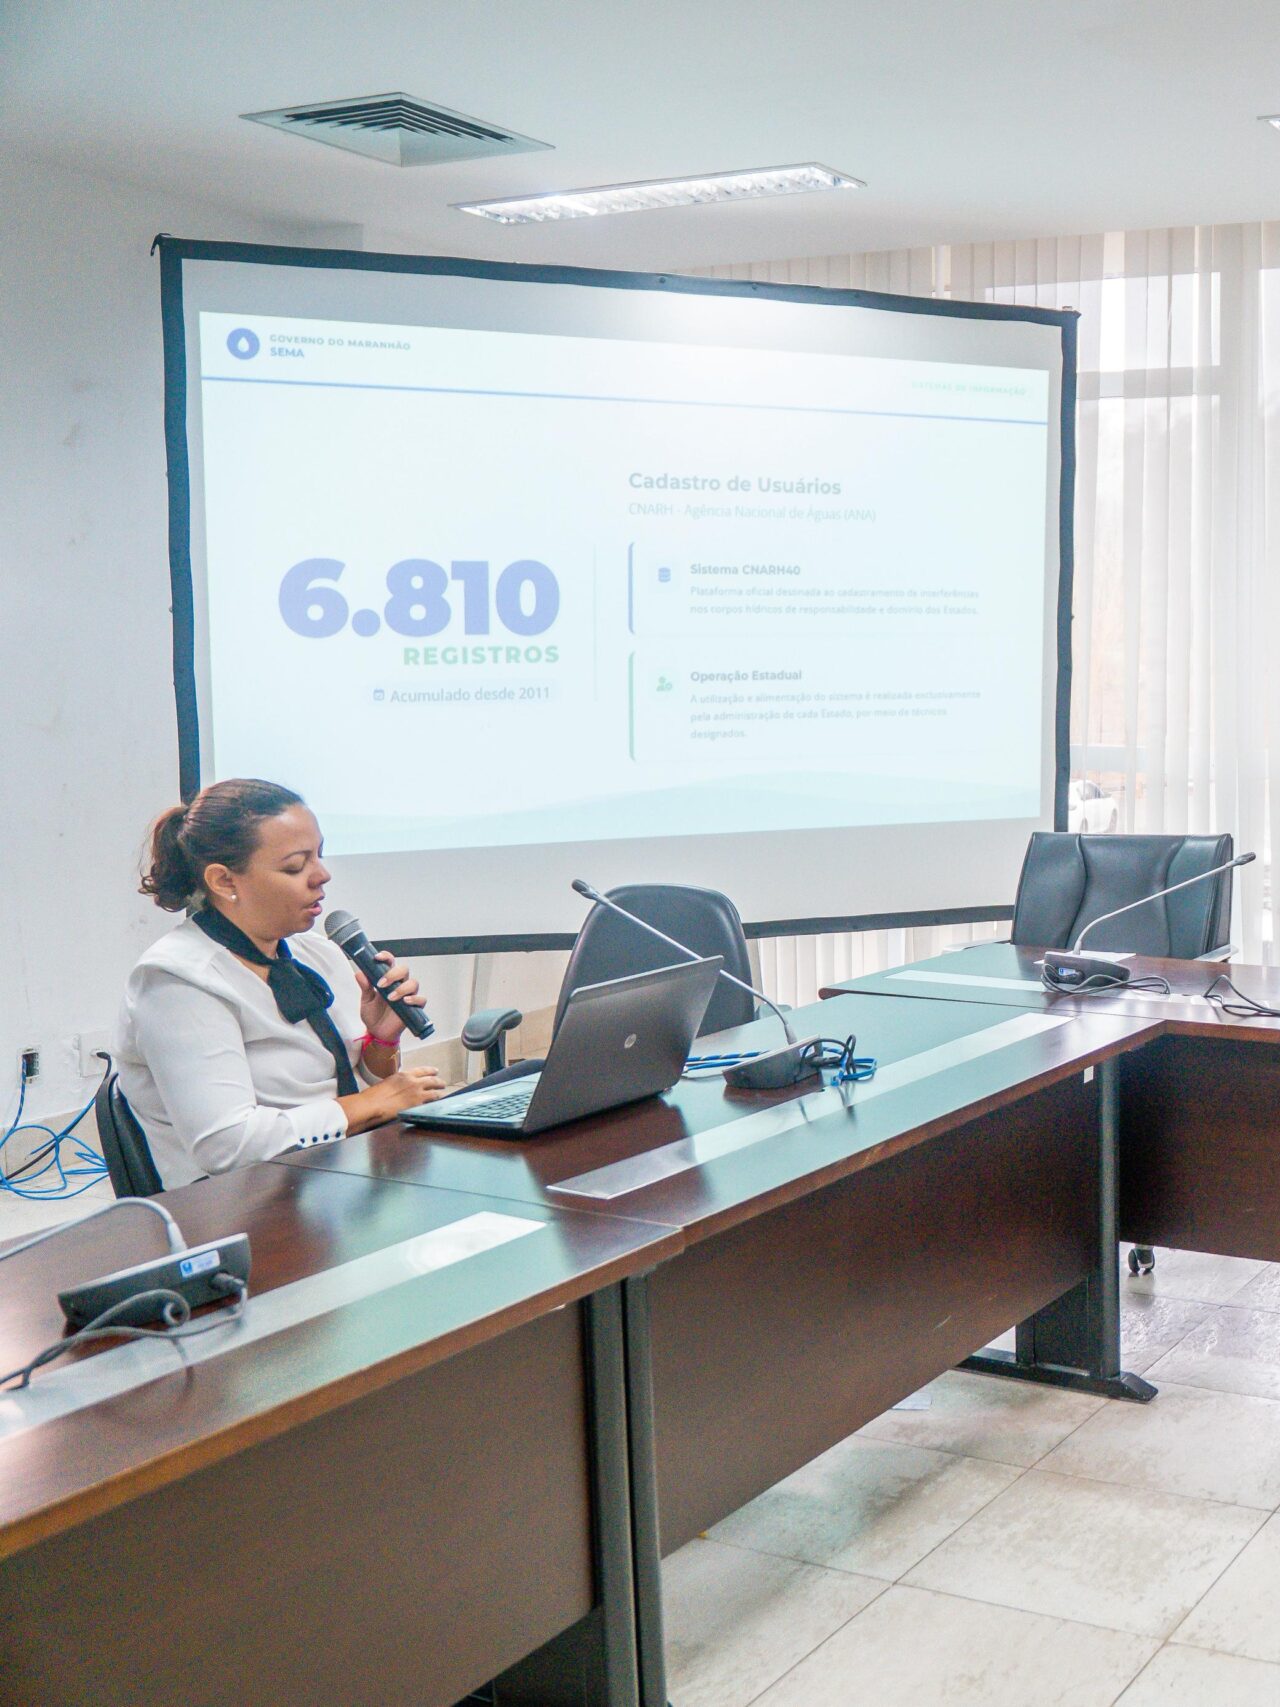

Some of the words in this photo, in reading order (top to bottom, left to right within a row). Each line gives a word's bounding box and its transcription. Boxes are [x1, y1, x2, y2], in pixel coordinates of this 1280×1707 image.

[270, 335, 325, 346] GOVERNO
[328, 338, 344, 347] DO
[347, 339, 411, 351] MARANHÃO
[270, 347, 305, 358] SEMA
[628, 472, 721, 491] Cadastro
[727, 475, 751, 492] de
[758, 476, 842, 495] Usuários
[628, 503, 674, 516] CNARH
[684, 503, 732, 520] Agência
[735, 504, 786, 519] Nacional
[789, 505, 804, 520] de
[806, 504, 842, 523] Águas
[843, 508, 877, 523] (ANA)
[690, 563, 739, 575] Sistema
[742, 564, 801, 576] CNARH40
[278, 557, 561, 639] 6.810
[690, 586, 743, 597] Plataforma
[746, 586, 774, 597] oficial
[824, 589, 835, 597] ao
[907, 587, 918, 598] de
[690, 605, 709, 614] nos
[710, 605, 743, 616] corpos
[785, 603, 797, 614] de
[925, 604, 941, 615] dos
[403, 645, 560, 666] REGISTROS
[690, 670, 749, 683] Operação
[752, 670, 803, 681] Estadual
[390, 688, 471, 703] Acumulado
[474, 686, 515, 701] desde
[519, 686, 550, 700] 2011
[690, 694, 698, 704] A
[700, 693, 745, 705] utilização
[755, 692, 811, 704] alimentação
[814, 691, 826, 701] do
[690, 711, 711, 723] pela
[713, 709, 780, 722] administração
[783, 709, 794, 719] de
[796, 708, 818, 719] cada
[856, 709, 871, 719] por
[874, 708, 897, 717] meio
[898, 707, 909, 717] de
